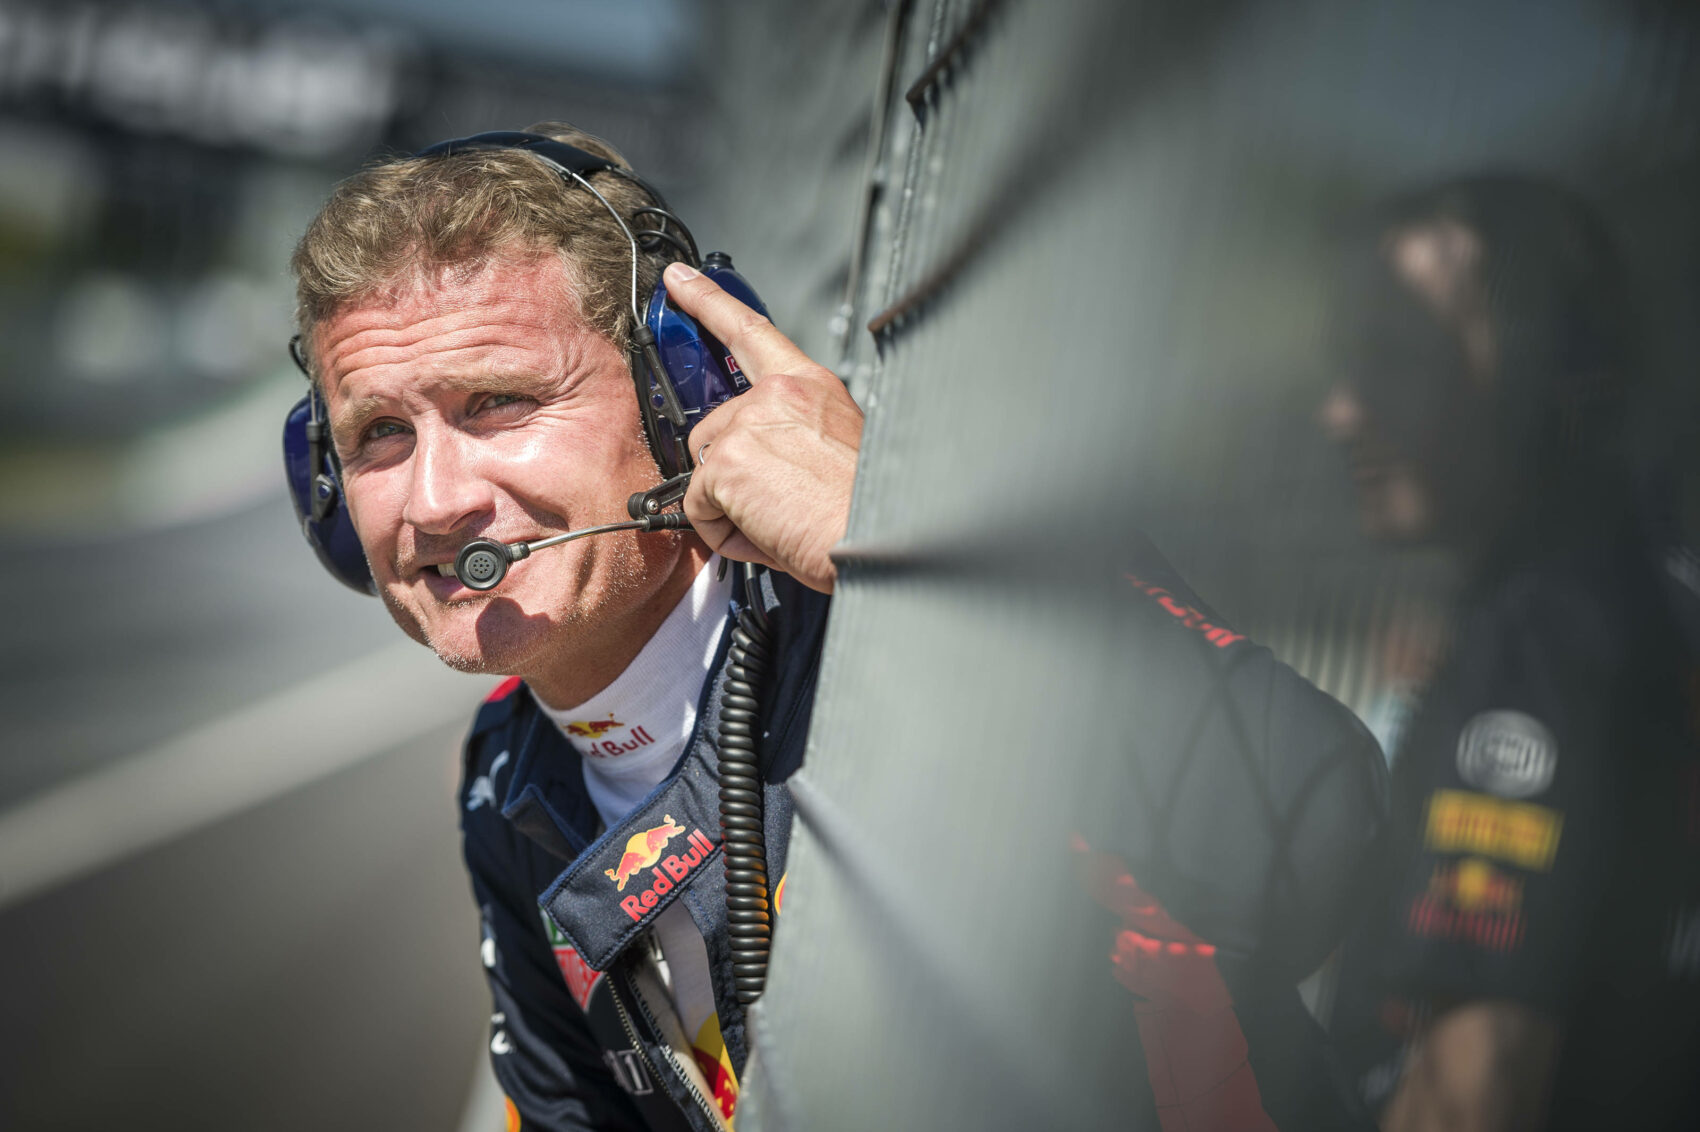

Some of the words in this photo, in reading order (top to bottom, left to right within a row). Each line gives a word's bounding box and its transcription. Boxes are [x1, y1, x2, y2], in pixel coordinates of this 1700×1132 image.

[601, 725, 655, 756] Bull
[620, 866, 674, 922] Red
[661, 828, 715, 883] Bull
